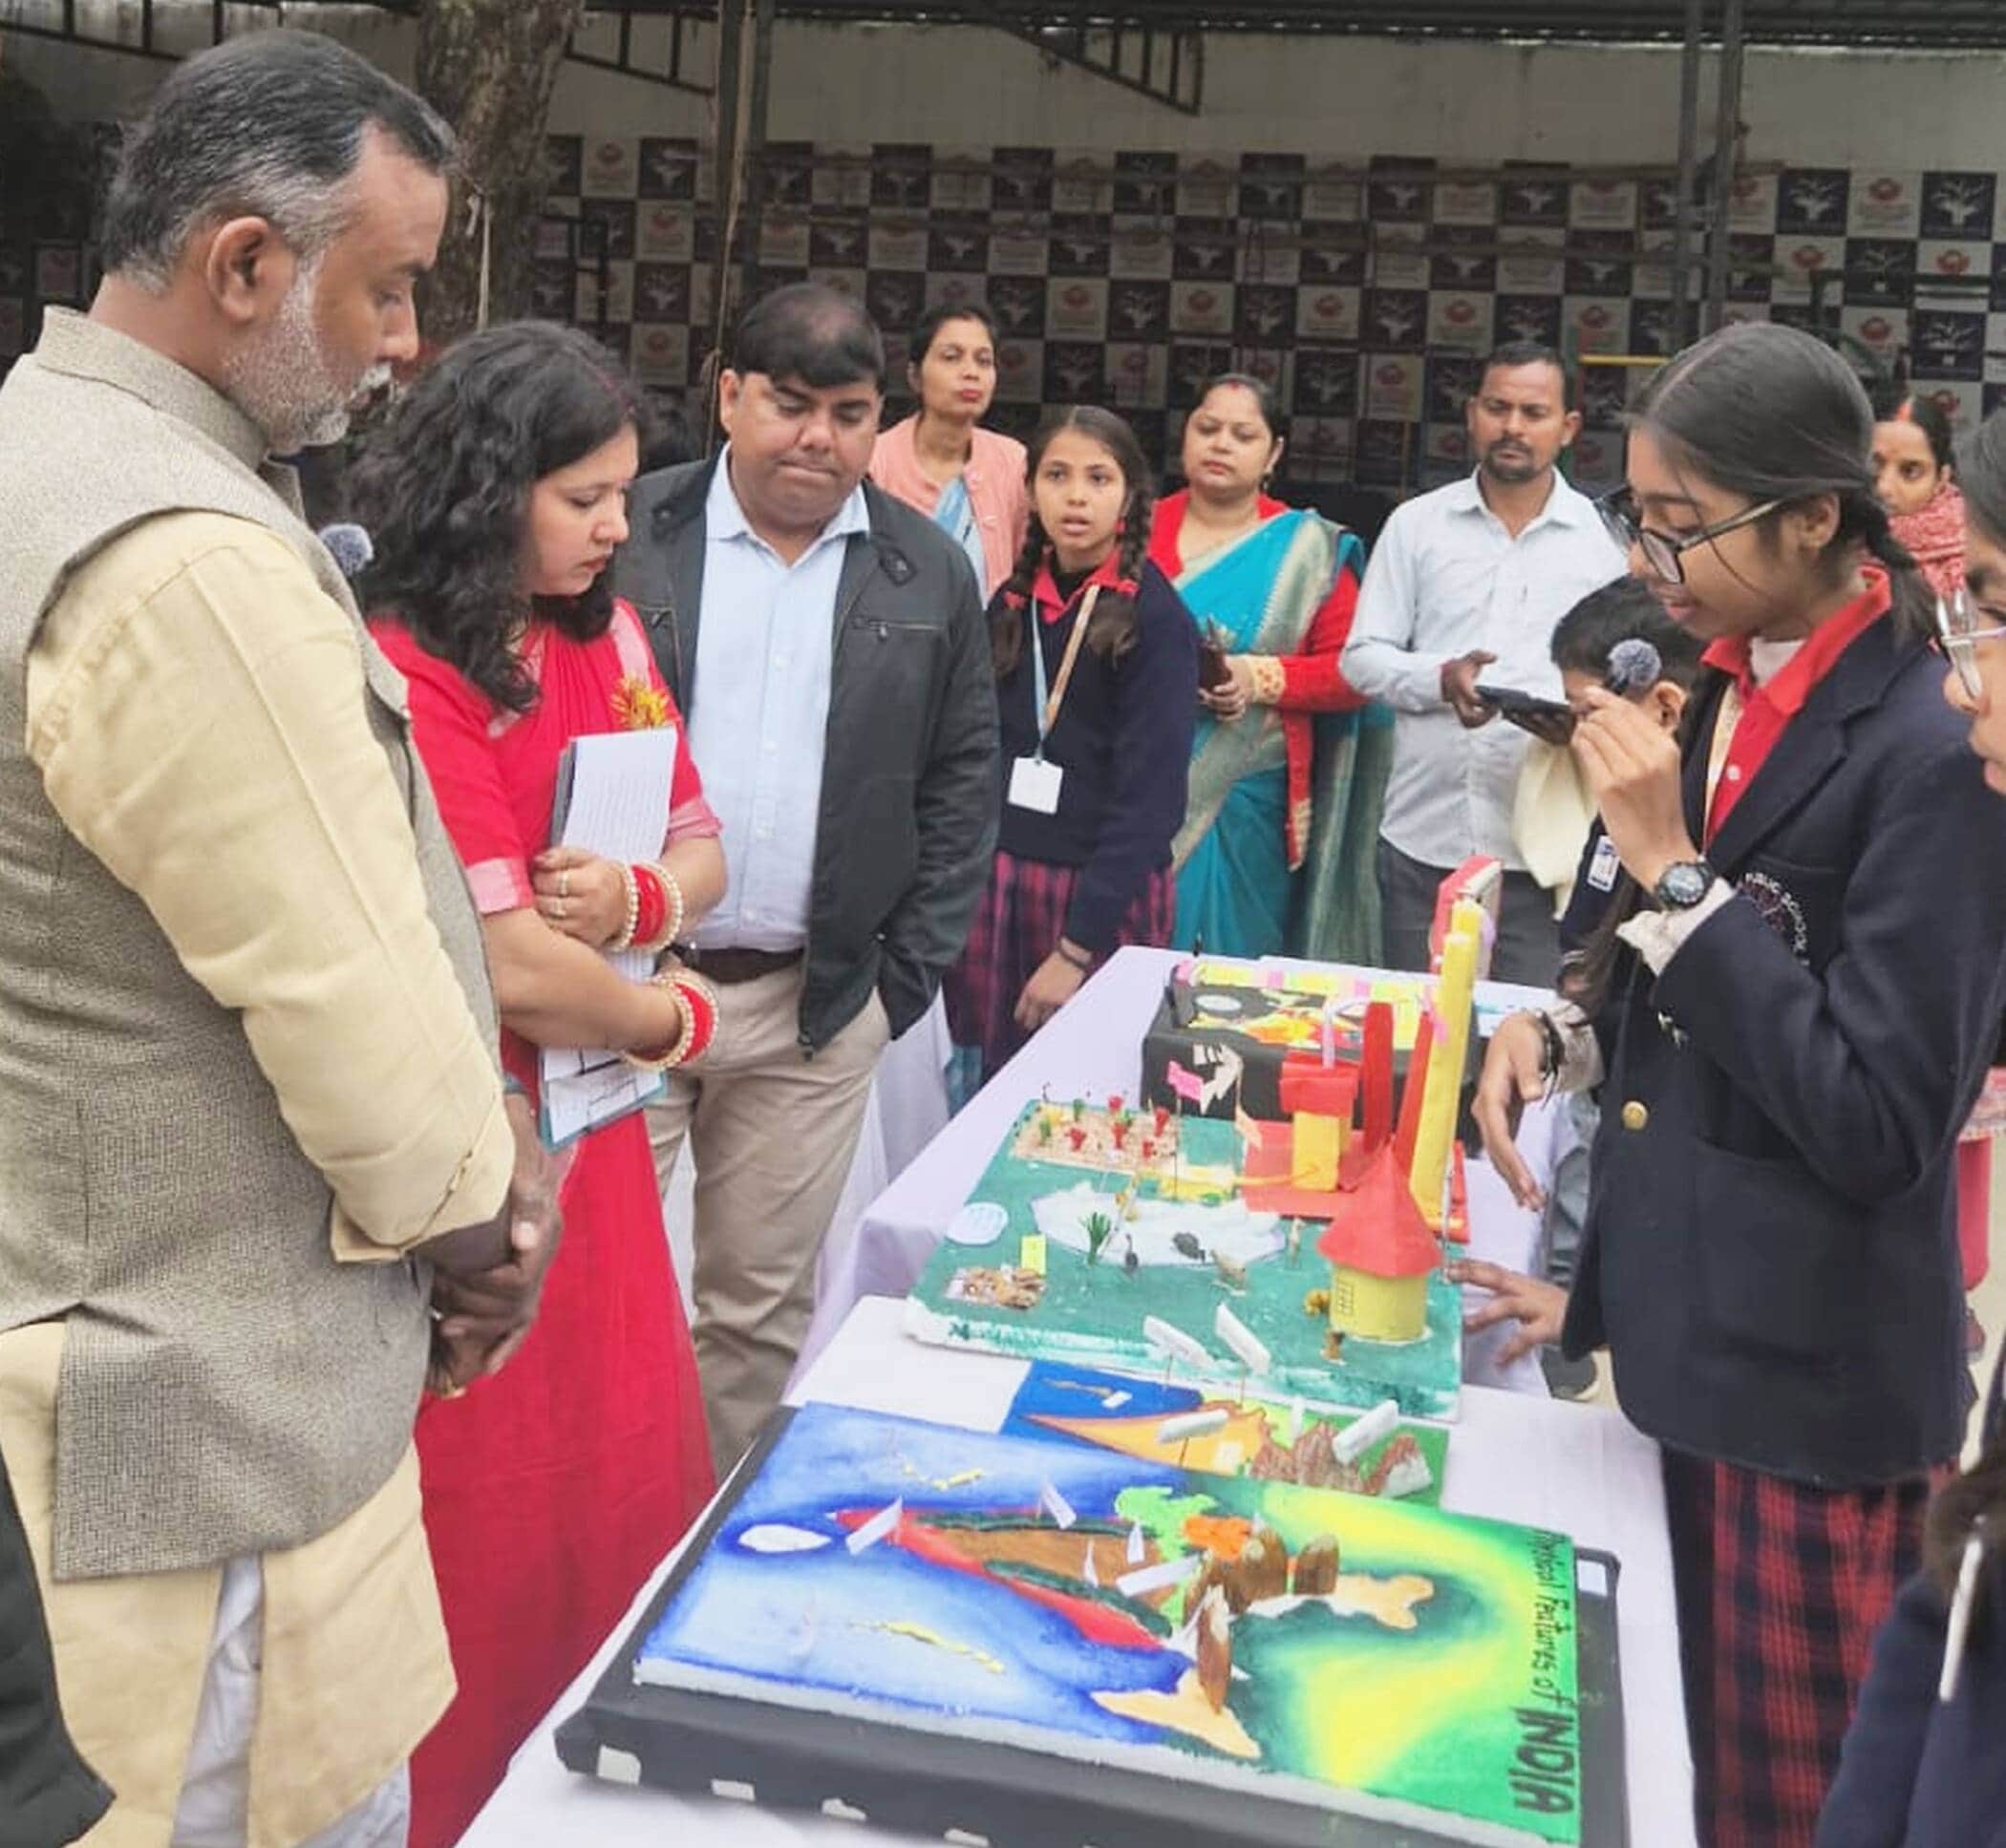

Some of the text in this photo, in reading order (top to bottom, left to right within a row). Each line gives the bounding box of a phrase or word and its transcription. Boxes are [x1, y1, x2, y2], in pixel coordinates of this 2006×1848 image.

[1531, 1593, 1572, 1670] Features
[1530, 1677, 1577, 1709] of
[1507, 1706, 1576, 1814] INDIA
